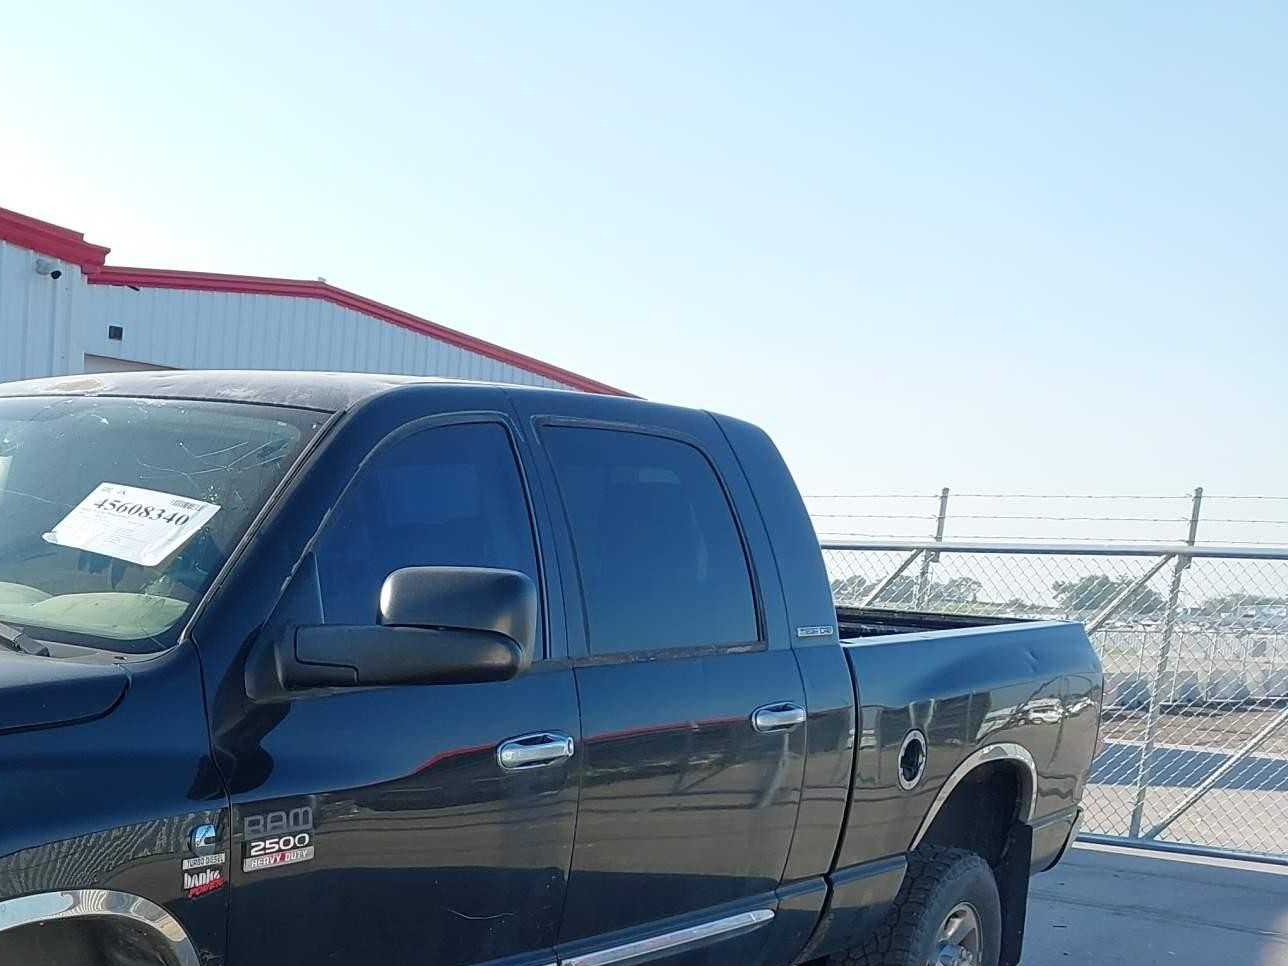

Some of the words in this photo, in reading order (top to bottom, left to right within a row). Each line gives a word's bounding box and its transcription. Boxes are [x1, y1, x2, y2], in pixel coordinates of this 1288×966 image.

[94, 498, 190, 526] 45608340
[244, 807, 313, 836] RAM
[251, 833, 310, 856] 2500
[251, 853, 283, 868] HEAVY
[285, 850, 308, 863] DUTY
